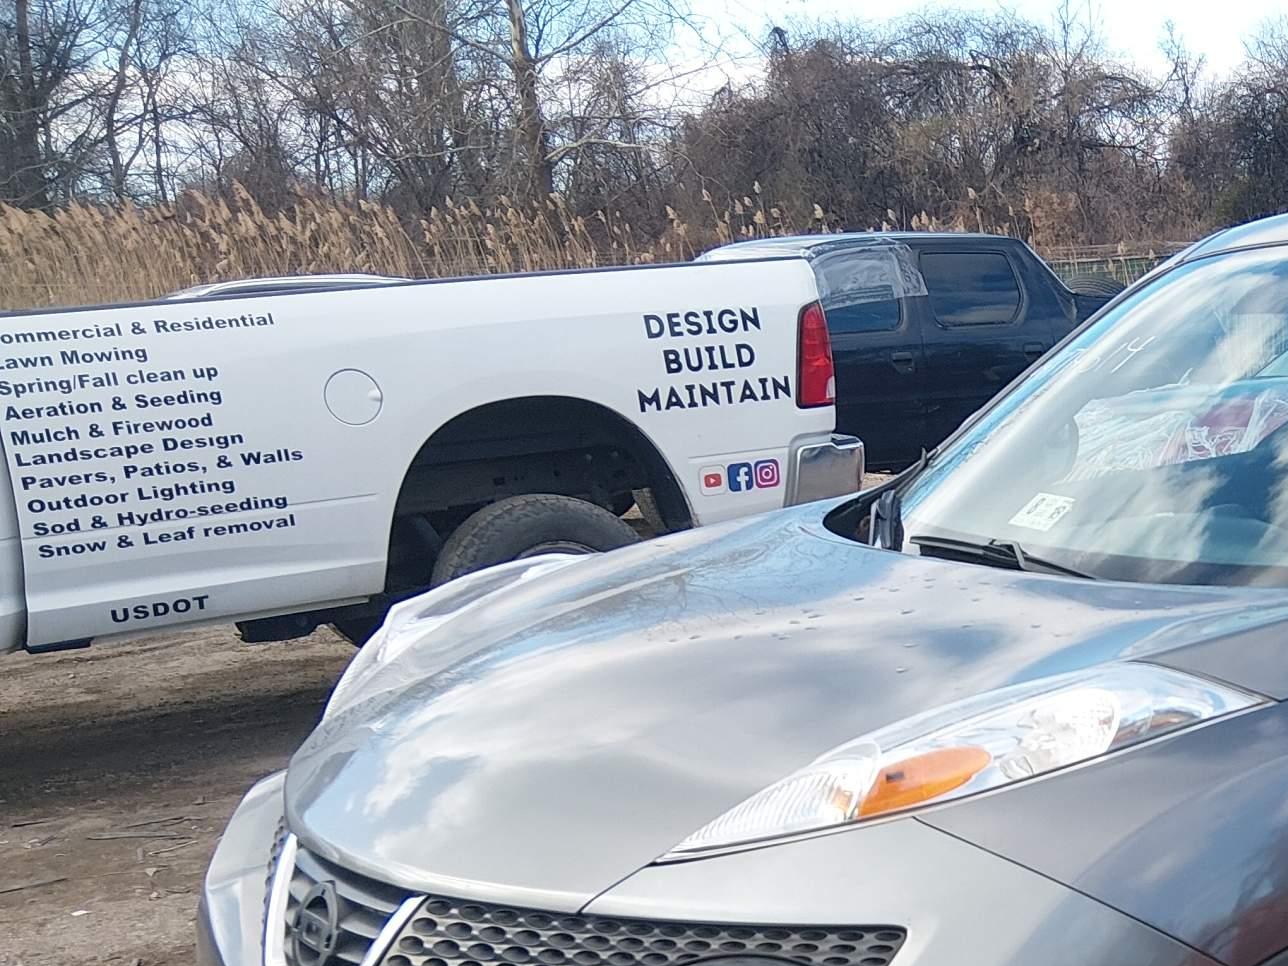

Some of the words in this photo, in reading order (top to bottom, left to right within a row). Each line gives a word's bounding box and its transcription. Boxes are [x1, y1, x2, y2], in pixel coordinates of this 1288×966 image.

[0, 322, 122, 345] ommercial
[131, 321, 147, 336] &
[154, 312, 275, 334] Residential
[643, 307, 761, 339] DESIGN
[60, 347, 148, 364] Mowing
[663, 343, 756, 374] BUILD
[0, 372, 119, 397] Spring/Fall
[126, 369, 186, 386] clean
[192, 365, 219, 383] up
[637, 375, 792, 413] MAINTAIN
[5, 401, 103, 421] Aeration
[112, 396, 127, 411] &
[136, 388, 223, 409] Seeding
[11, 426, 80, 446] Mulch
[89, 423, 105, 438] &
[112, 413, 213, 436] Firewood
[15, 443, 154, 467] Landscape
[162, 433, 244, 451] Design
[21, 471, 116, 491] Pavers,
[124, 459, 208, 479] Patios,
[216, 455, 233, 469] &
[241, 448, 304, 466] Walls
[27, 491, 129, 514] Outdoor
[137, 478, 236, 501] Lighting
[33, 518, 81, 536] Sod
[91, 515, 108, 529] &
[117, 496, 288, 526] Hydro-seeding
[38, 540, 107, 559] Snow
[117, 534, 134, 549] &
[143, 526, 196, 546] Leaf
[203, 514, 296, 537] removal
[110, 595, 210, 623] USDOT
